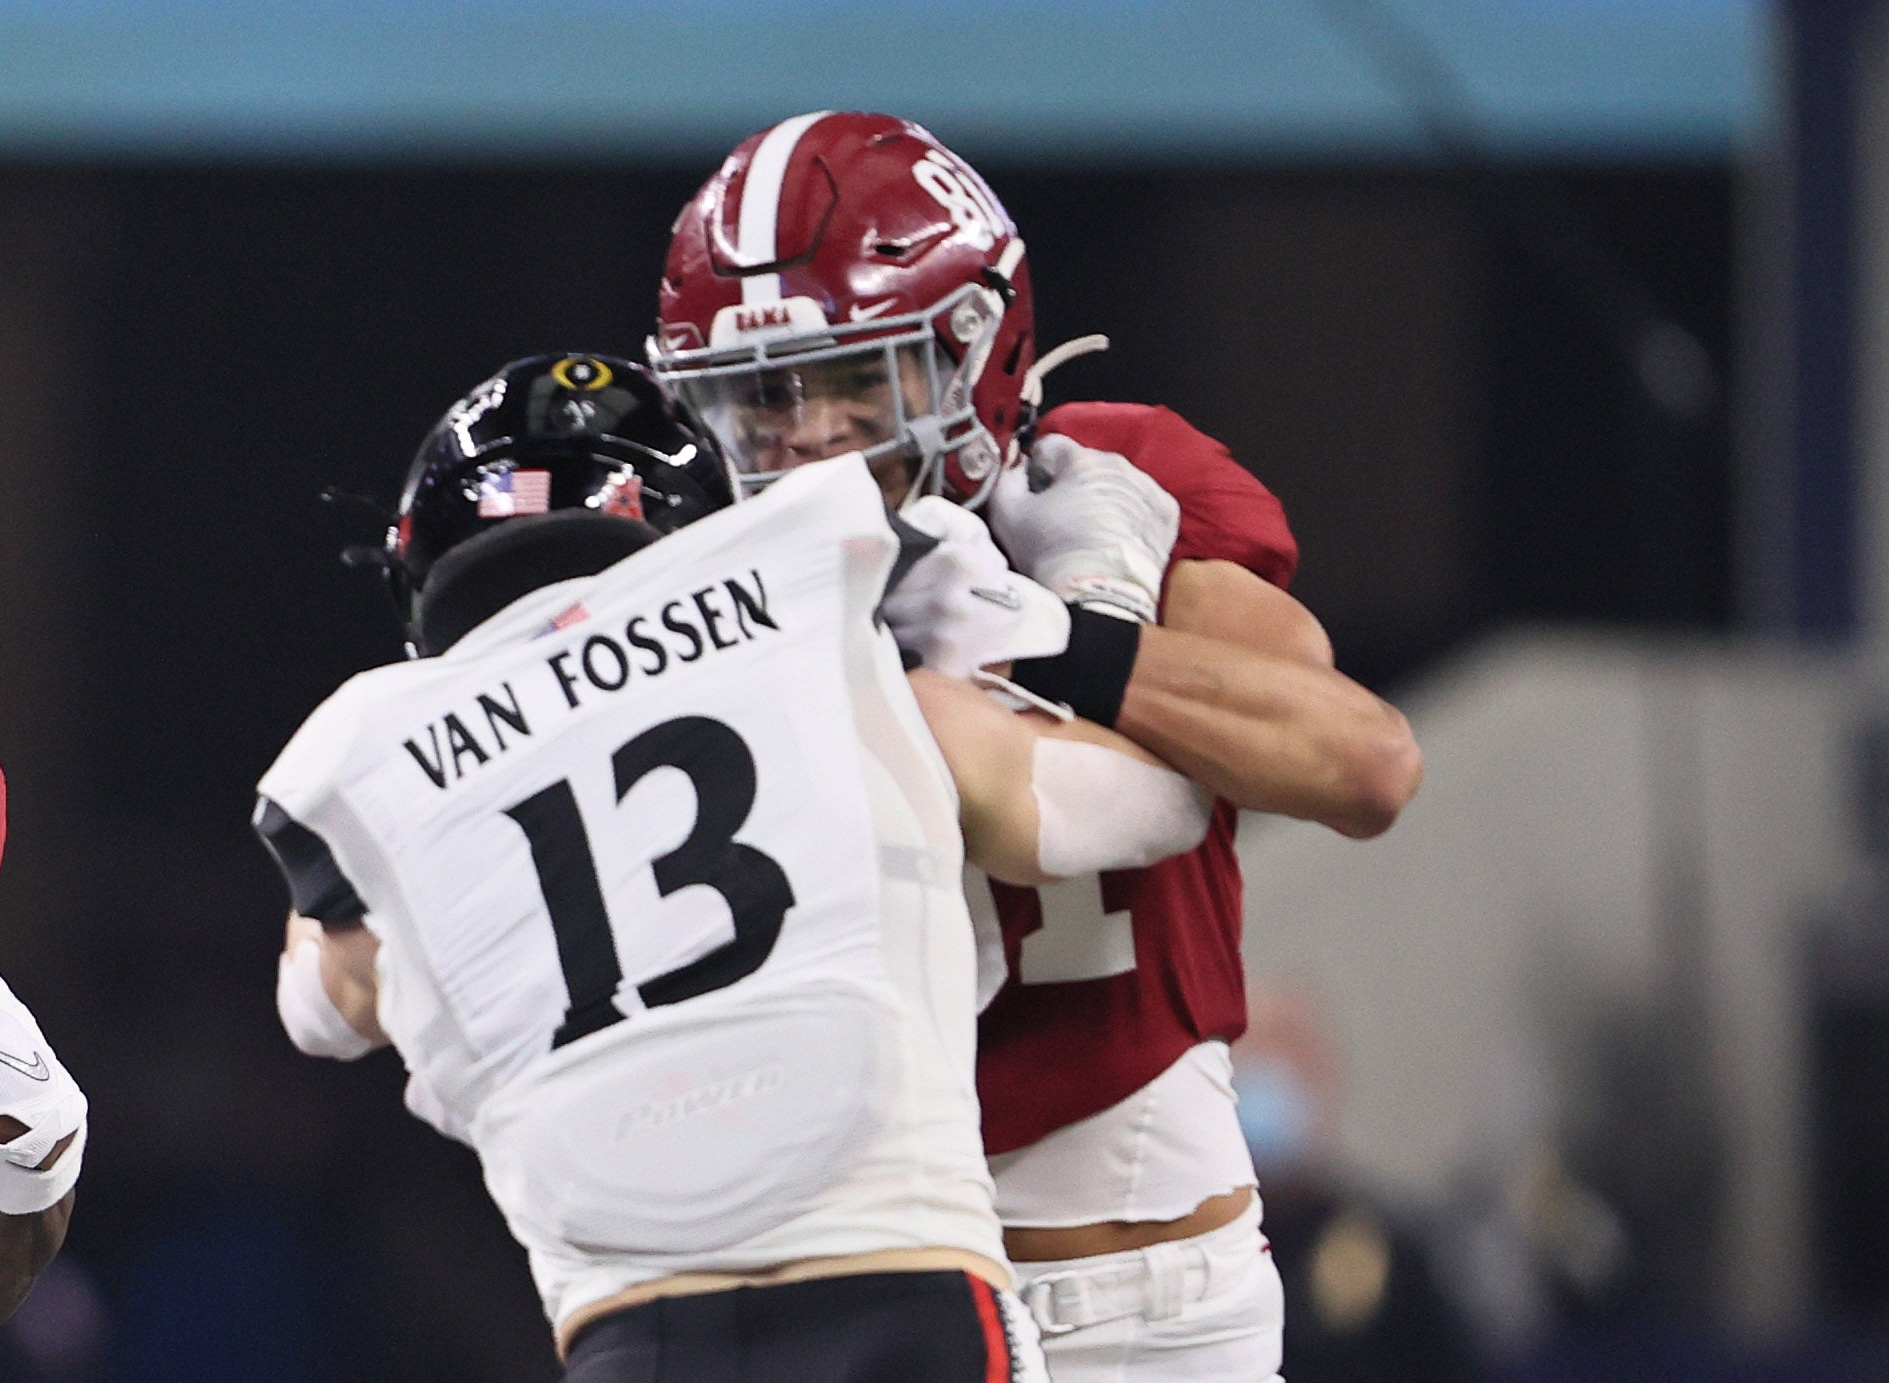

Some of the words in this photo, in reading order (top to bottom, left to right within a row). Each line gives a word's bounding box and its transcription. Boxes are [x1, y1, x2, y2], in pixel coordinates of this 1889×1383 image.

[402, 683, 532, 790] VAN
[547, 570, 781, 708] FOSSEN
[502, 715, 796, 1051] 13
